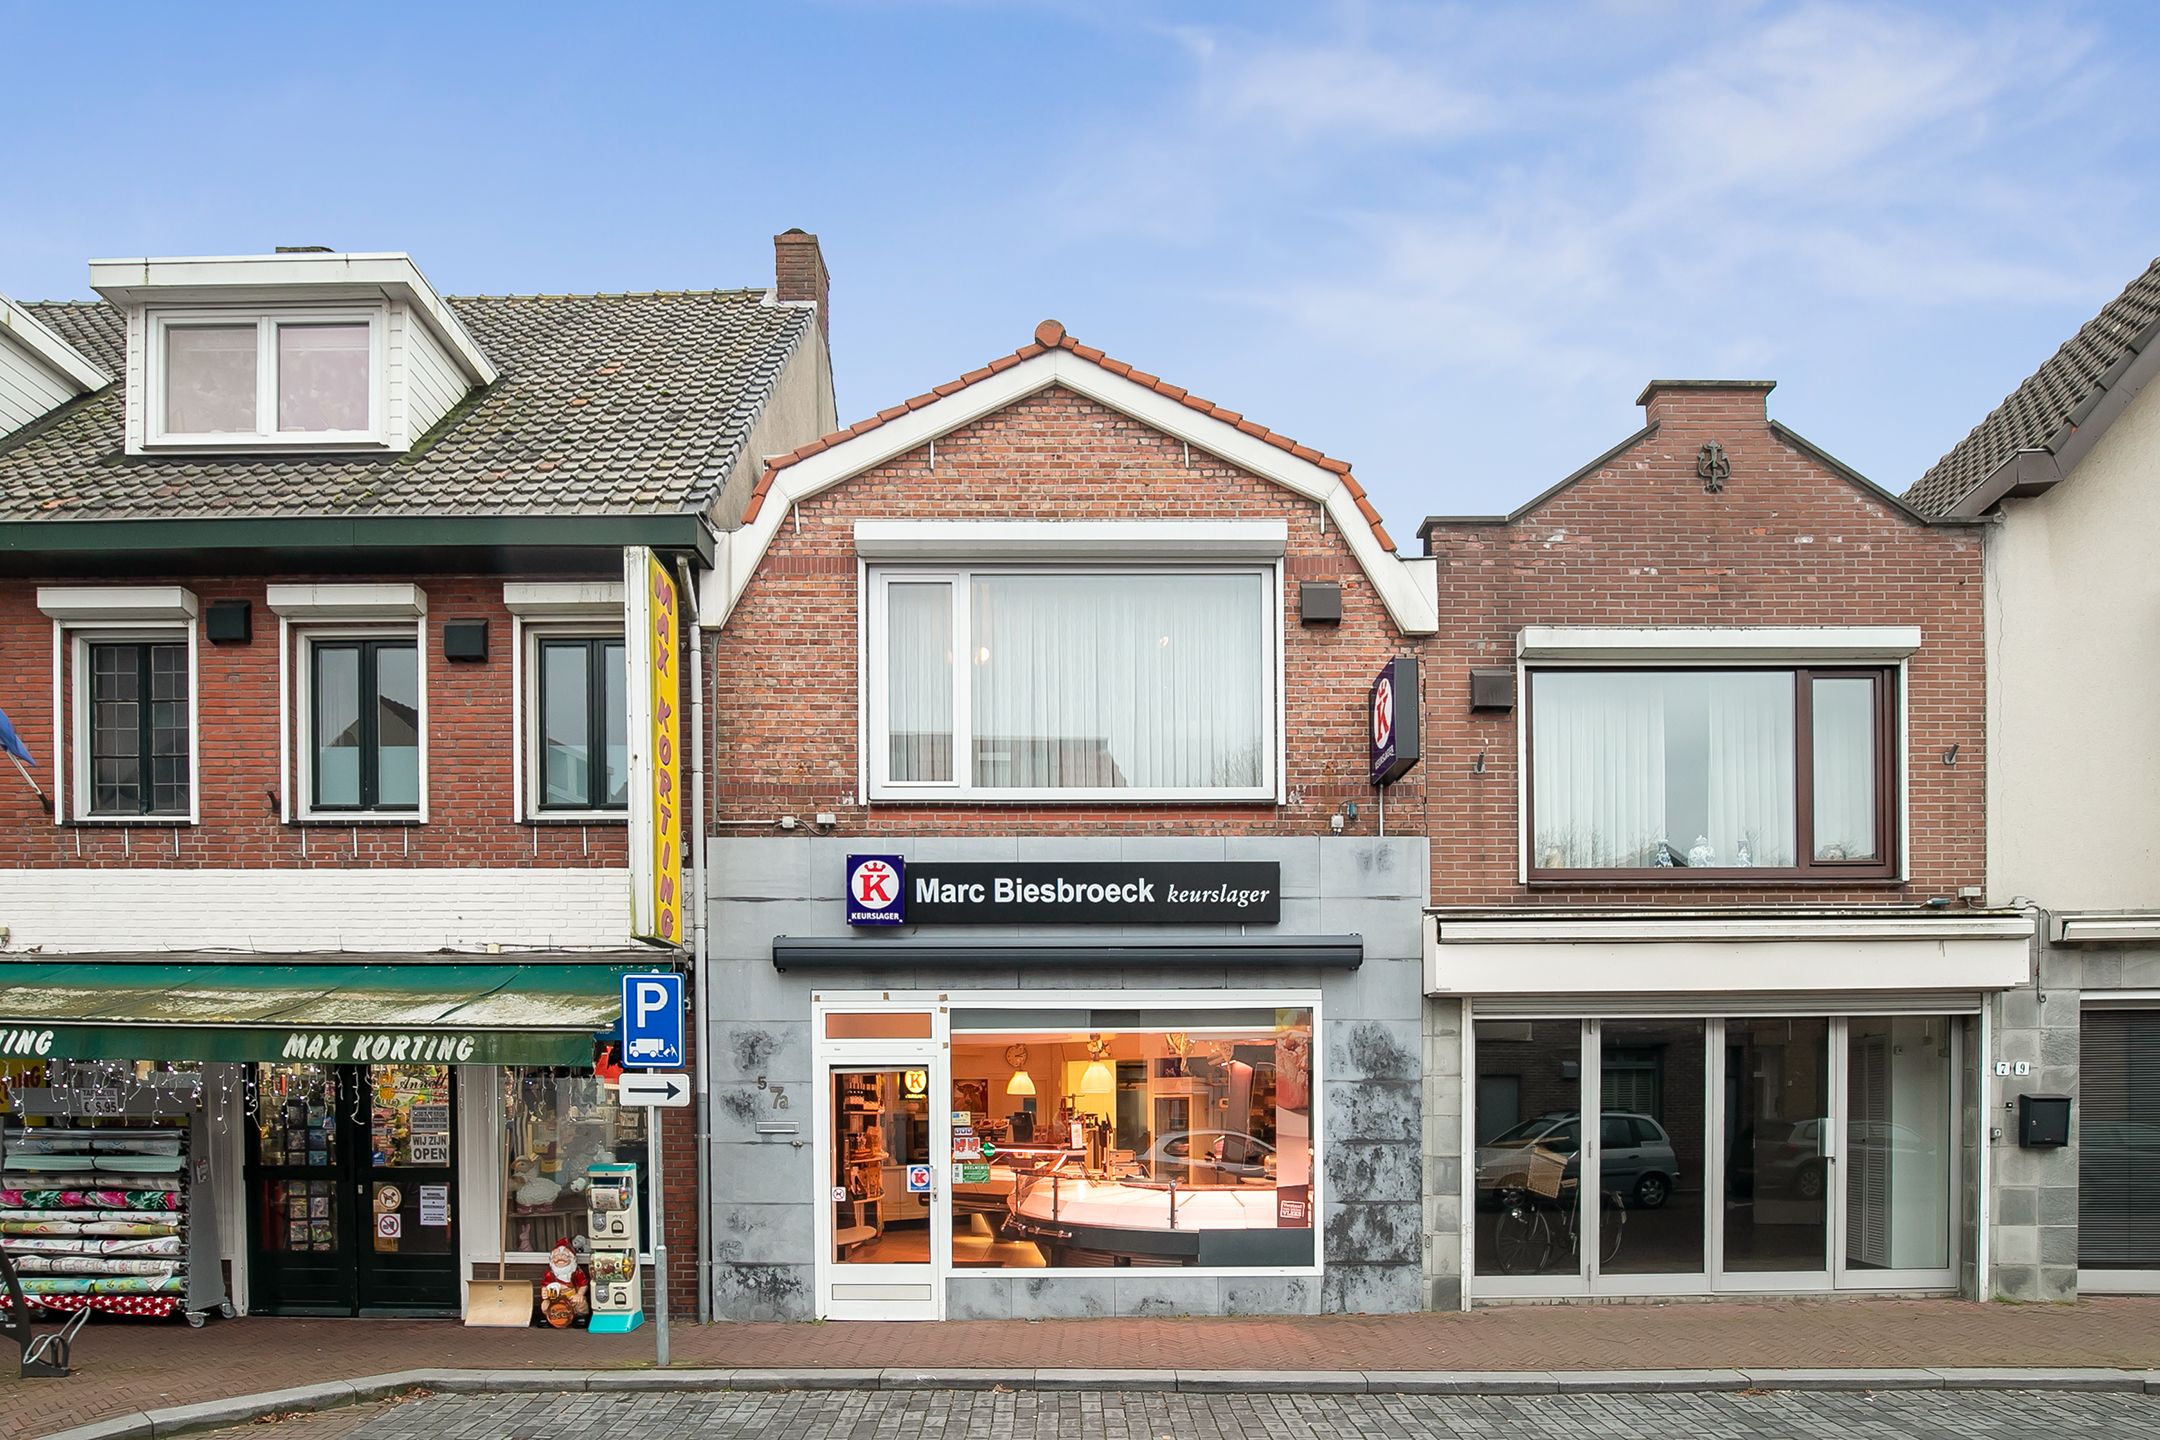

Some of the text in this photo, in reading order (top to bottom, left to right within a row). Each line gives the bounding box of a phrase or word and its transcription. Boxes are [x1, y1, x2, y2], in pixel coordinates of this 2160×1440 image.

[1377, 693, 1389, 742] K
[655, 573, 674, 940] MAX KORTING
[860, 874, 891, 902] K
[916, 877, 1270, 908] Marc Biesbroeck keurslager
[851, 912, 900, 920] KEURSLAGER
[637, 982, 668, 1028] P
[282, 1033, 475, 1061] MAX KORTING
[757, 1076, 789, 1109] 5 7a
[910, 1073, 923, 1088] K
[412, 1135, 447, 1147] WIJ ZIJN
[413, 1148, 448, 1161] OPEN
[914, 1172, 927, 1184] K
